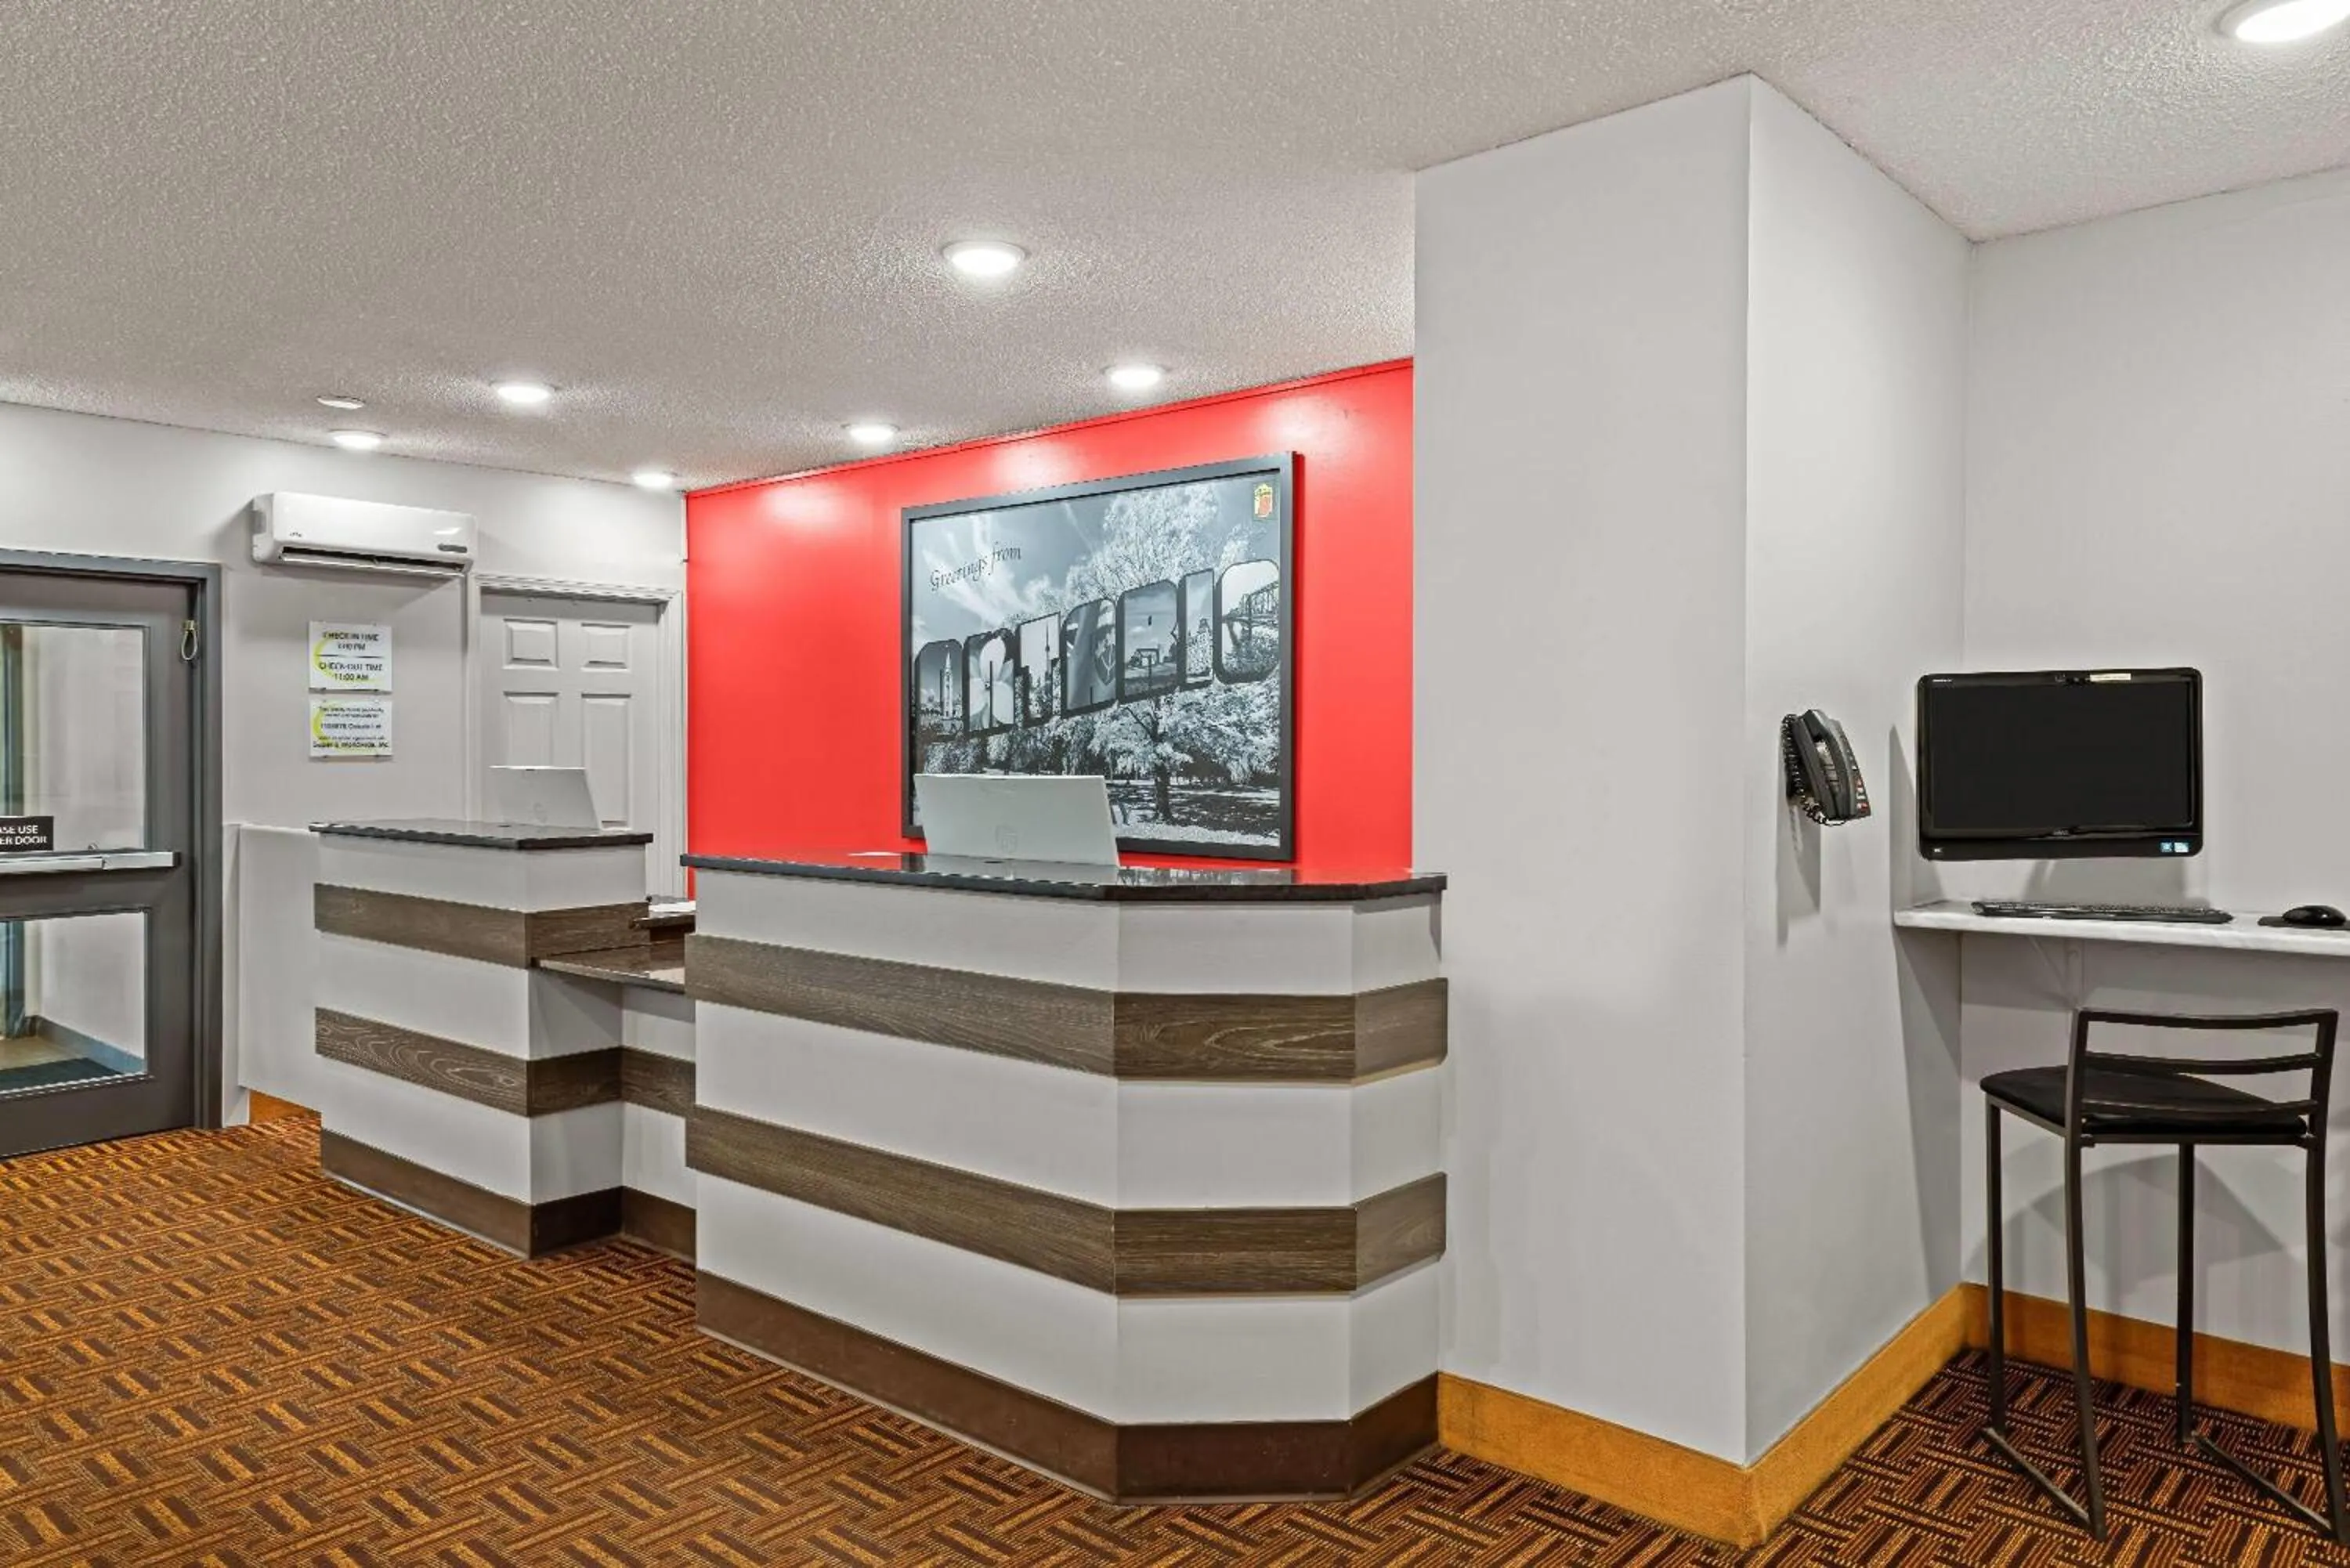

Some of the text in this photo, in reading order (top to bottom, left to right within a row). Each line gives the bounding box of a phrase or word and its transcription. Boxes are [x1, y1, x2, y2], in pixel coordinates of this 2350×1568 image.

[930, 541, 1021, 591] Greetings from
[18, 825, 38, 834] USE
[16, 836, 48, 845] DOOR
